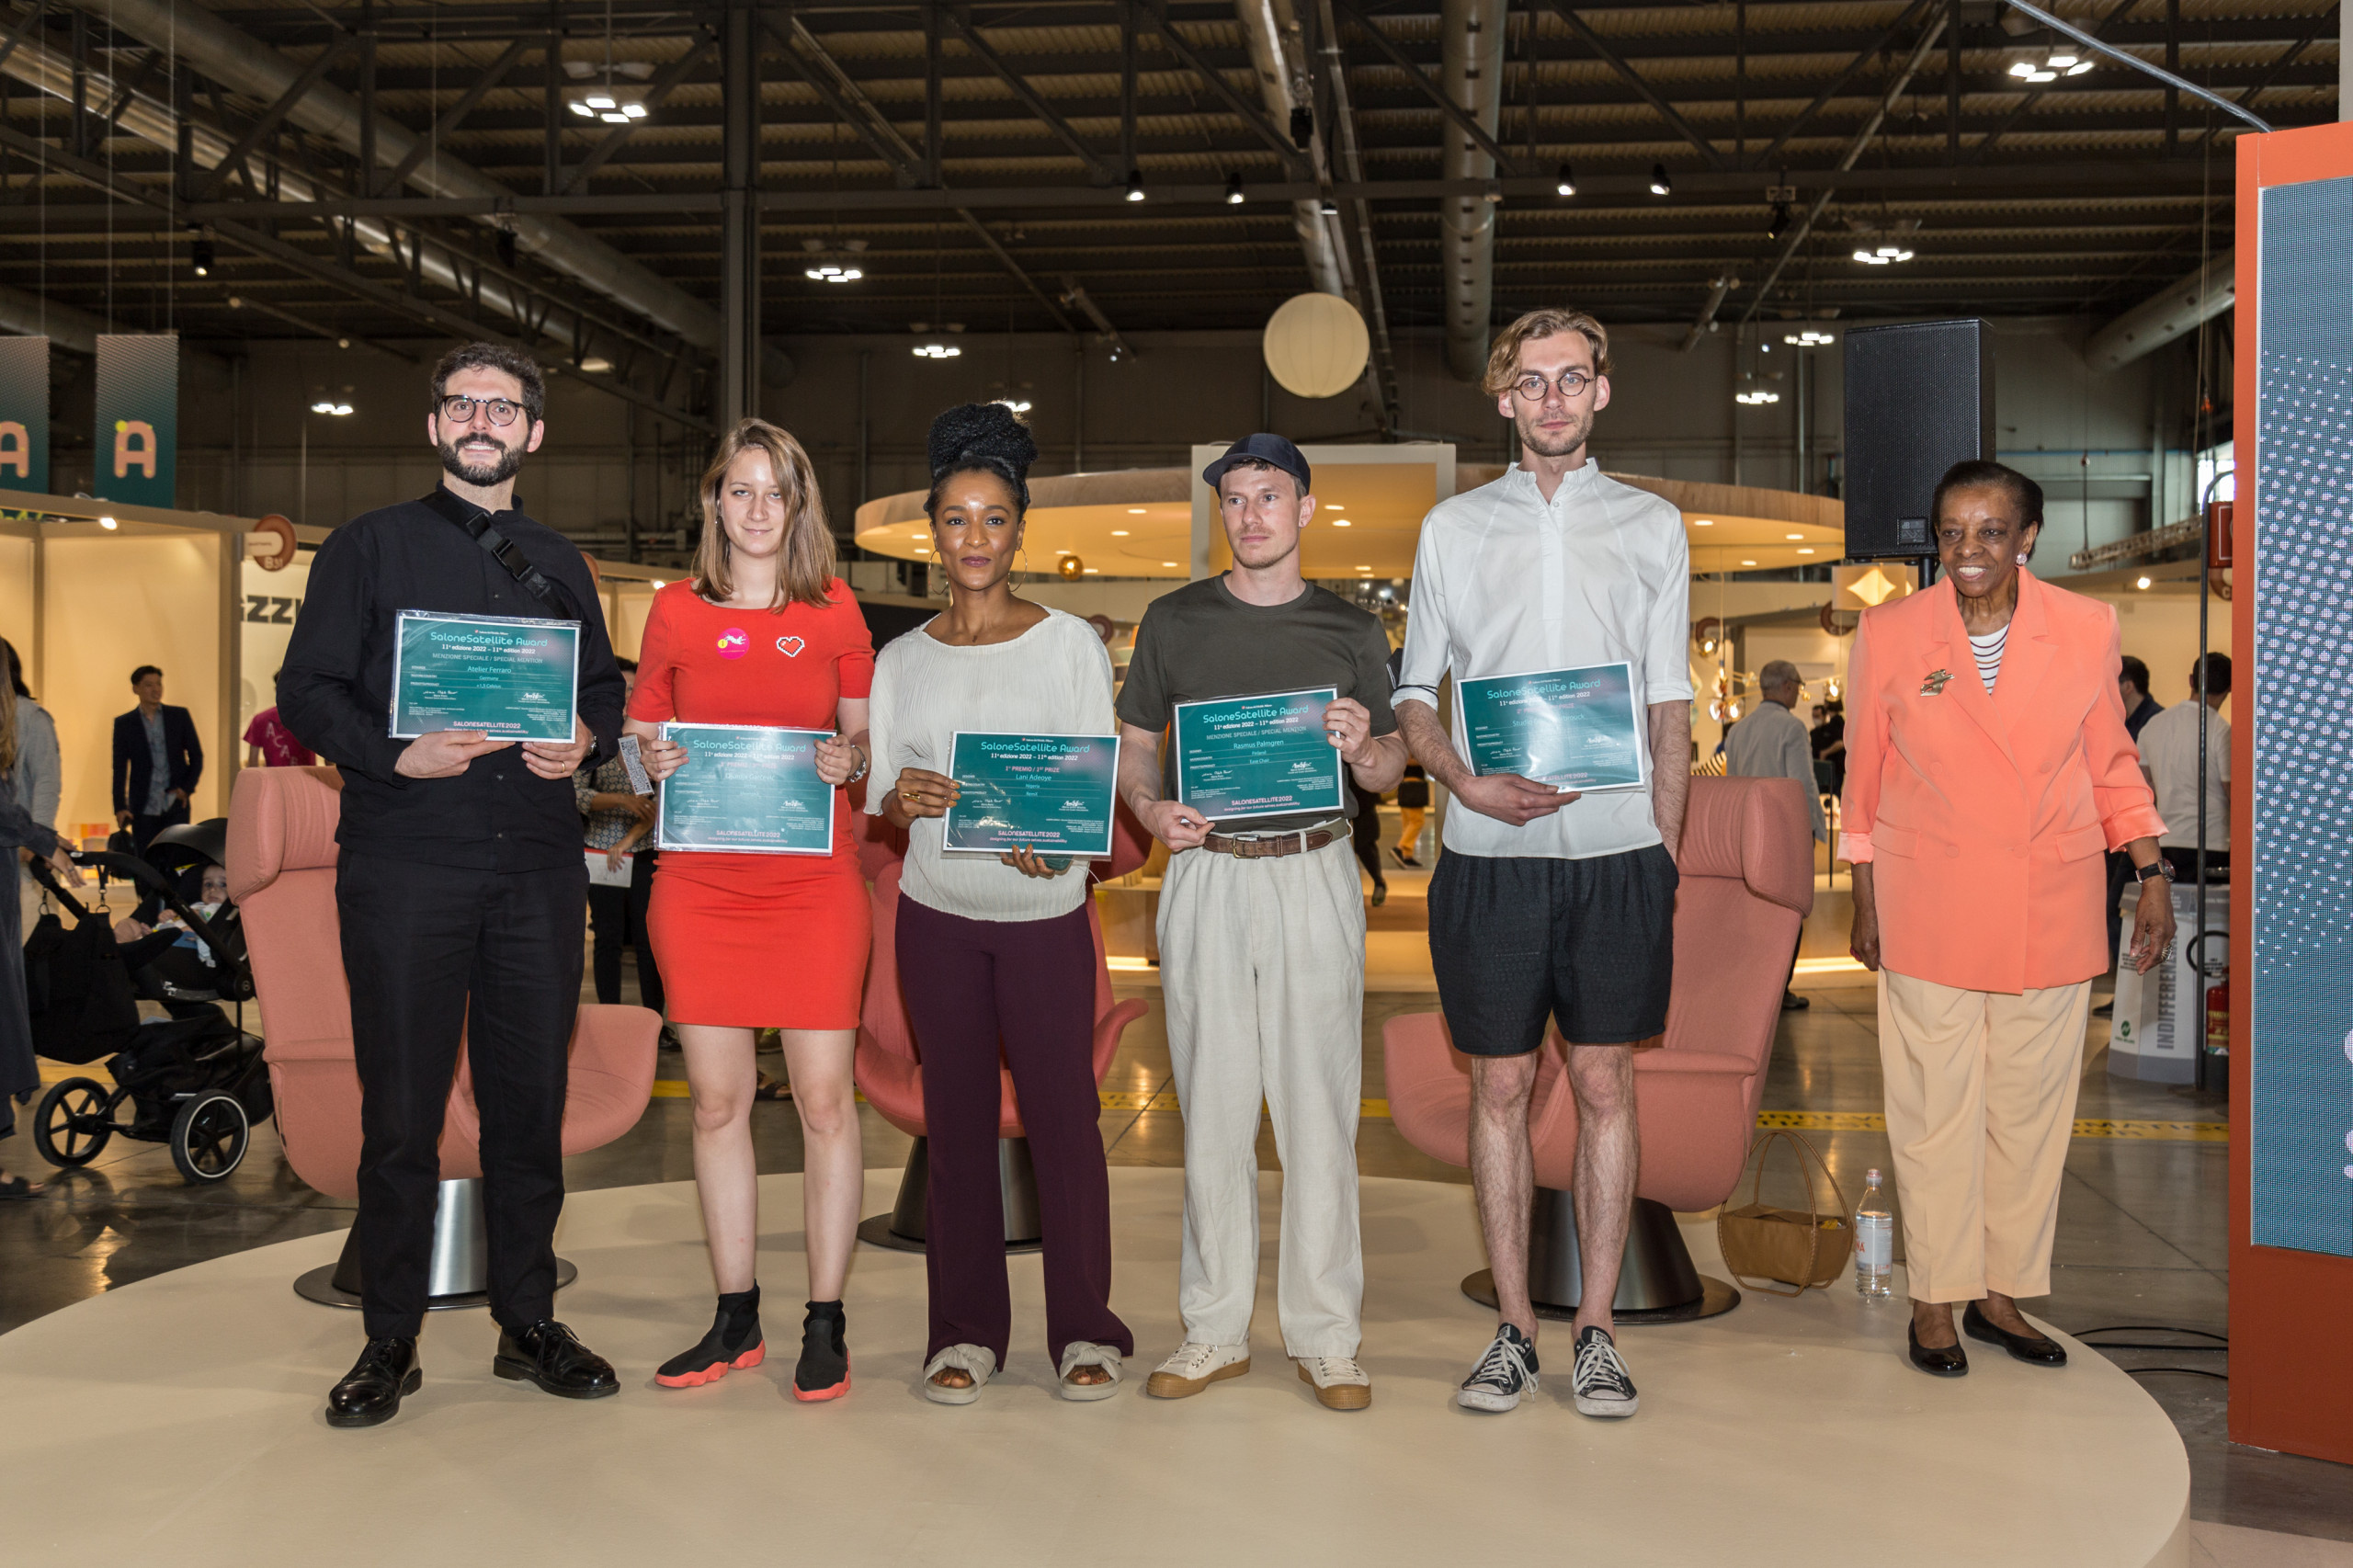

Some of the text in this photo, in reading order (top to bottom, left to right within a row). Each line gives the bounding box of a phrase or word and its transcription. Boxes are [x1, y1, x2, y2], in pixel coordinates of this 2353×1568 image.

[430, 631, 514, 645] SaloneSatellite
[516, 637, 548, 647] Award
[432, 653, 461, 661] MENZIONE
[467, 665, 488, 674] Atelier
[1486, 683, 1567, 699] SaloneSatellite
[1569, 678, 1601, 690] Award
[1202, 709, 1278, 723] SaloneSatellite
[1279, 704, 1309, 716] Award
[1206, 733, 1233, 741] MENZIONE
[693, 739, 806, 753] SaloneSatellite Award
[981, 741, 1058, 752] SaloneSatellite
[1059, 744, 1090, 754] Award
[1233, 742, 1256, 750] Rasmus
[1029, 774, 1052, 782] Adeoye
